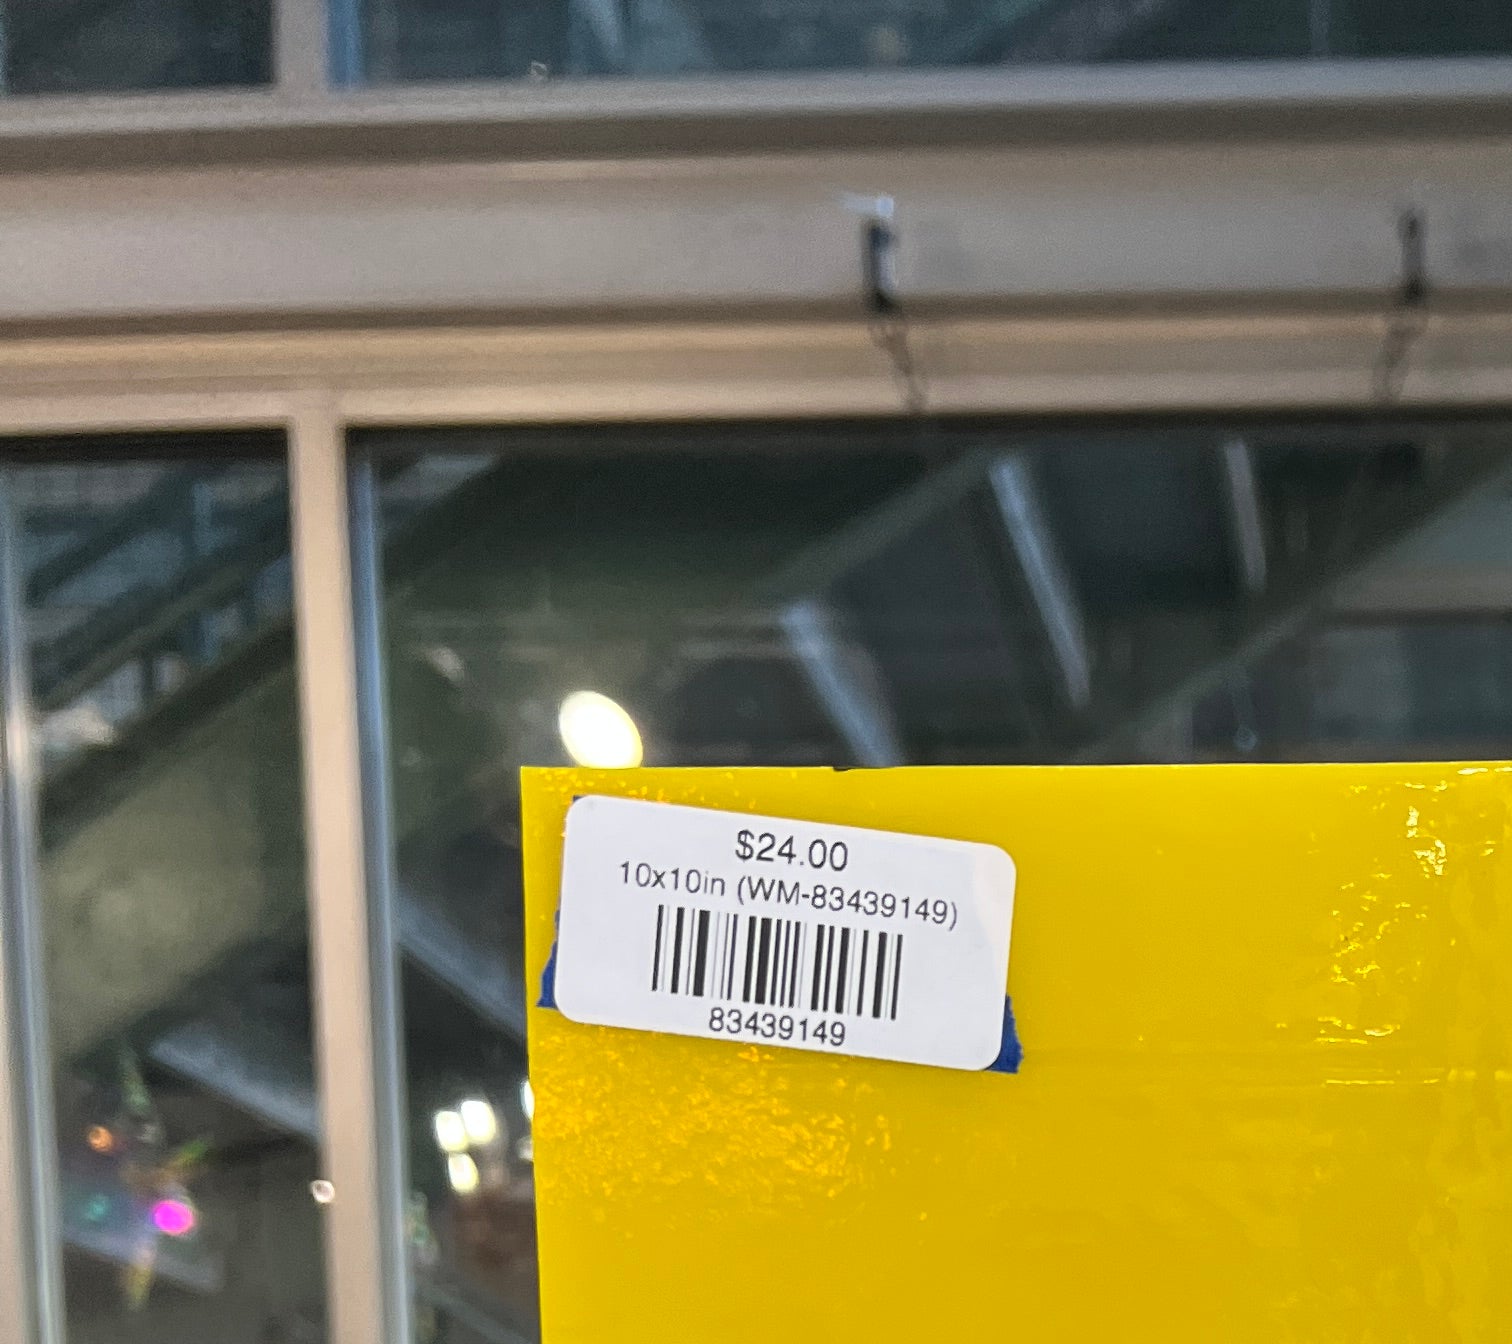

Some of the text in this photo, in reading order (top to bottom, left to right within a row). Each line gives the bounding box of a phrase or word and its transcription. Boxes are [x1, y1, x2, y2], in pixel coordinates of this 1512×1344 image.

[735, 829, 849, 872] $24.00
[619, 861, 959, 931] 10x10in (WM-83439149)
[708, 1007, 847, 1047] 83439149
